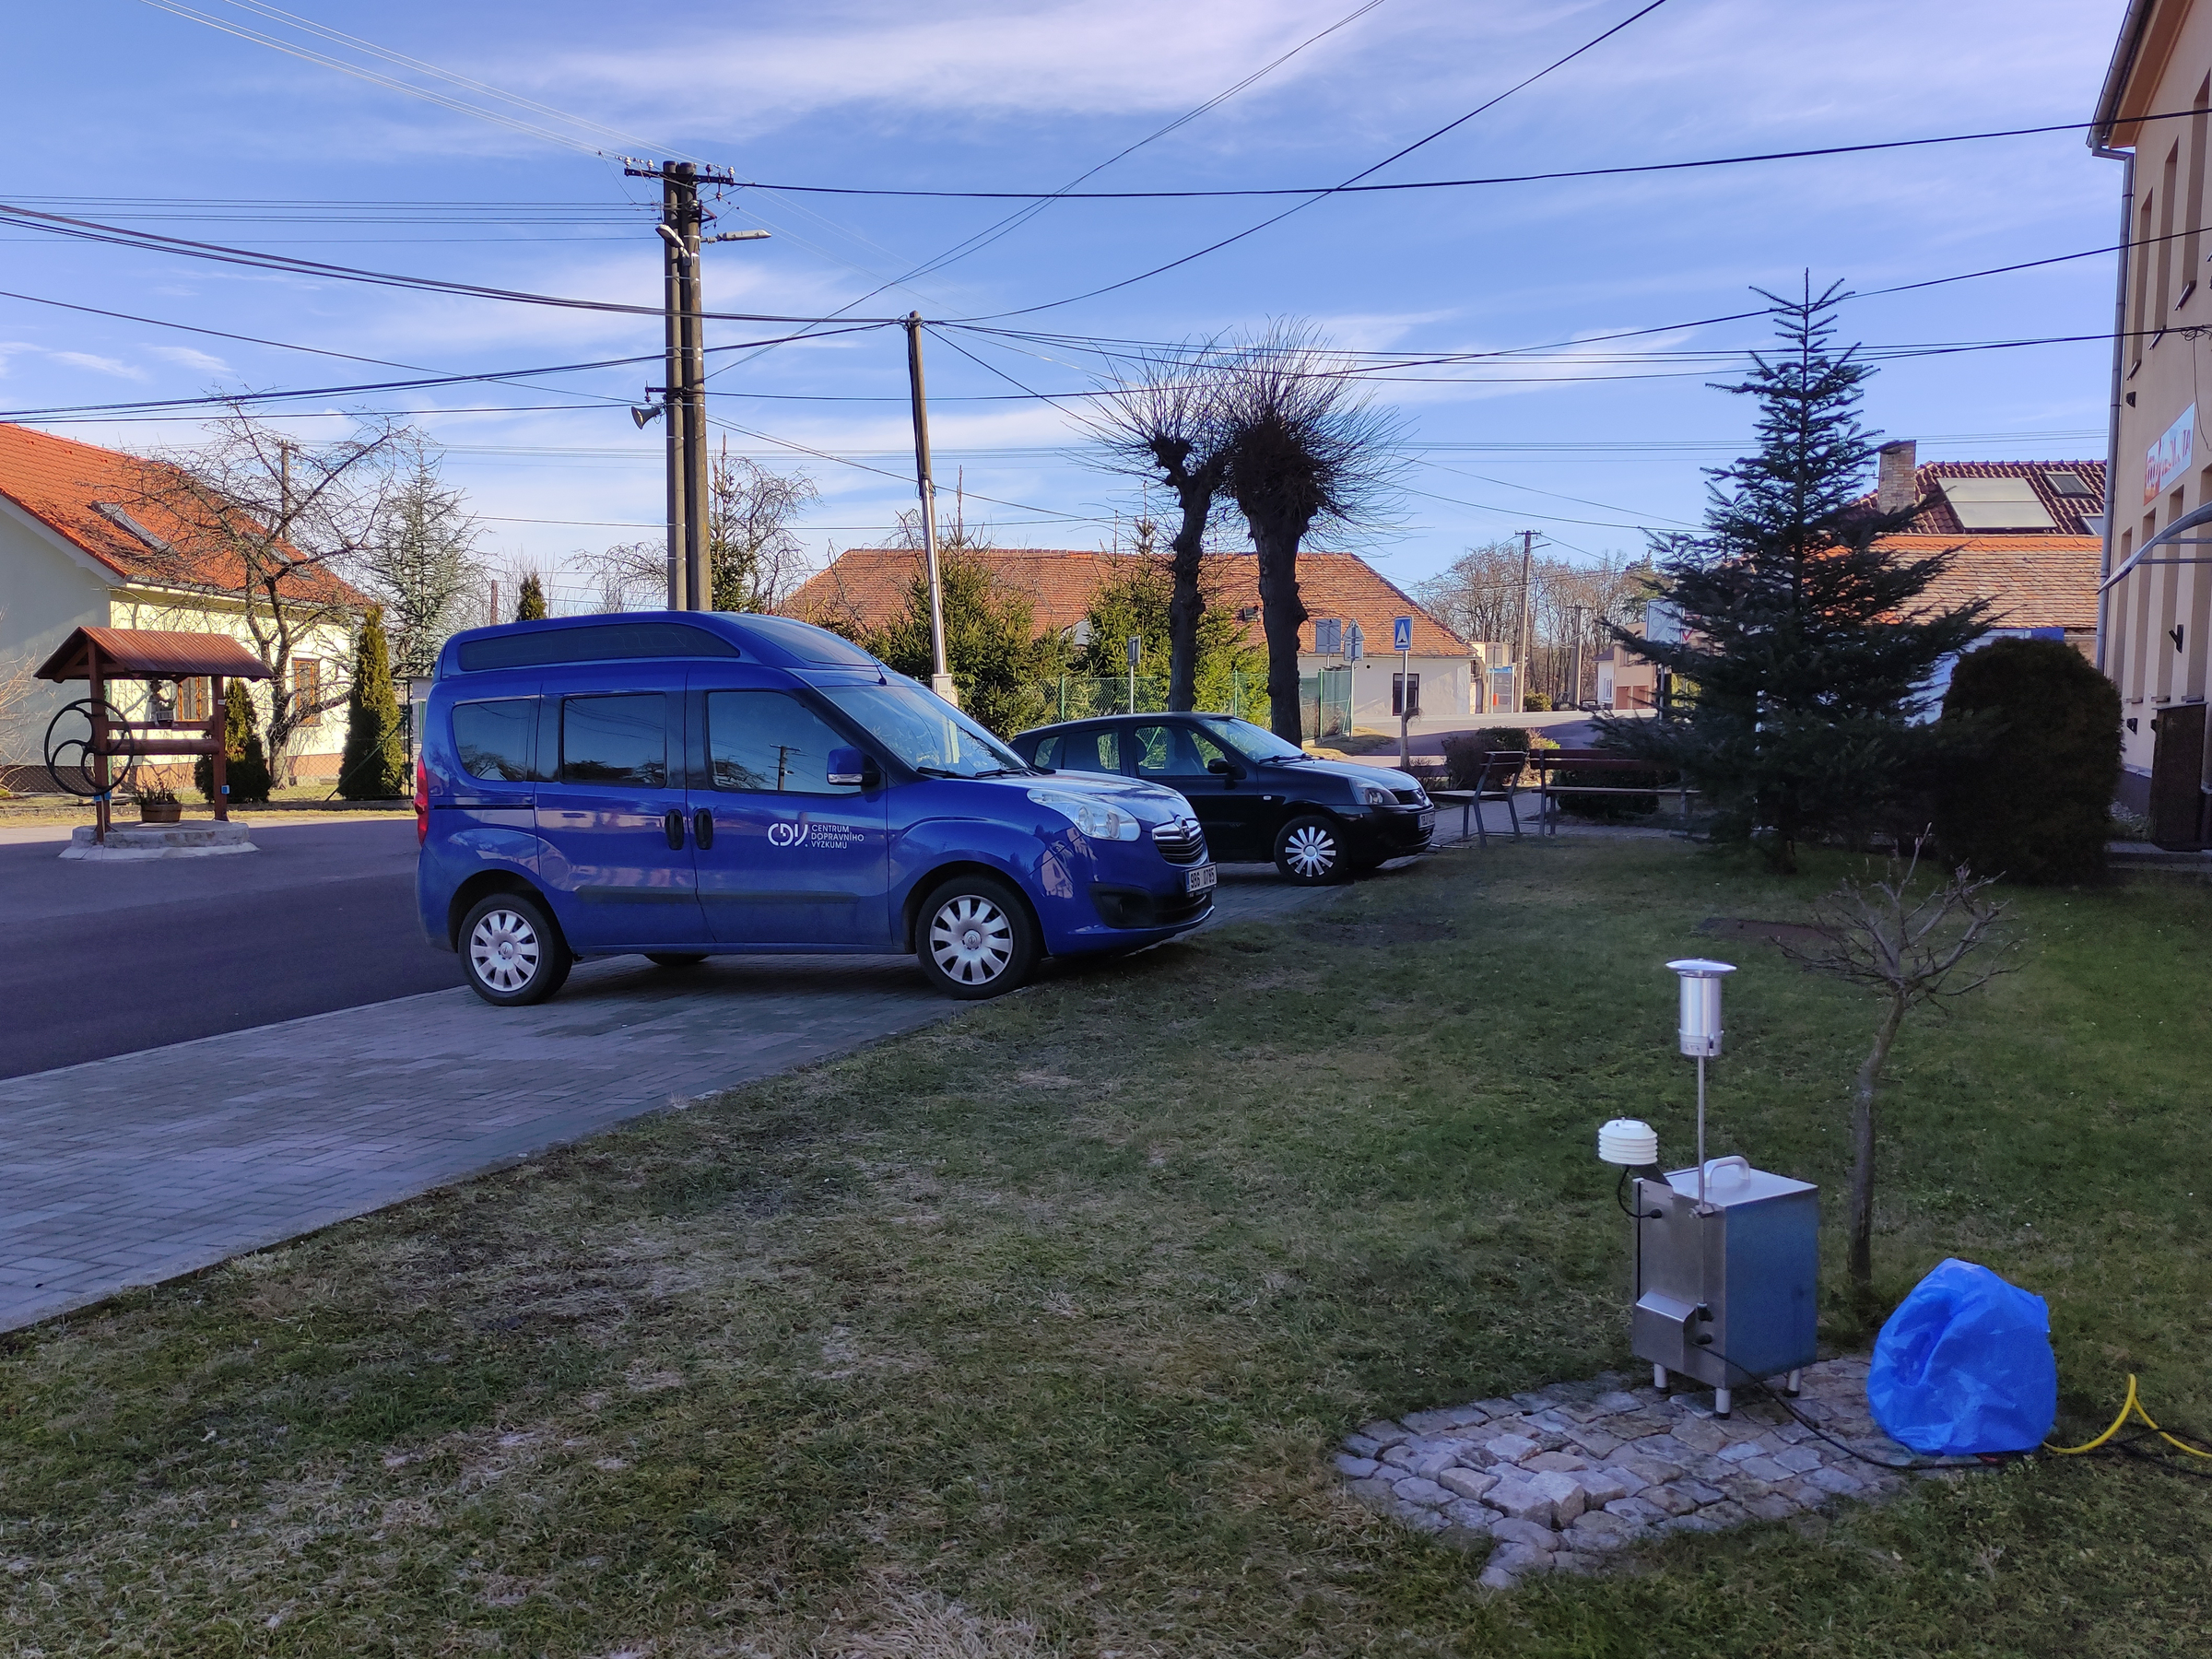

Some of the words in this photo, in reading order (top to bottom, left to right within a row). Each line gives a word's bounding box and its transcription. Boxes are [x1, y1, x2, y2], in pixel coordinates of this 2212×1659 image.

[811, 824, 850, 832] CENTRUM
[811, 832, 865, 841] DOPRAVNÍHO
[811, 840, 848, 849] VÝZKUMU
